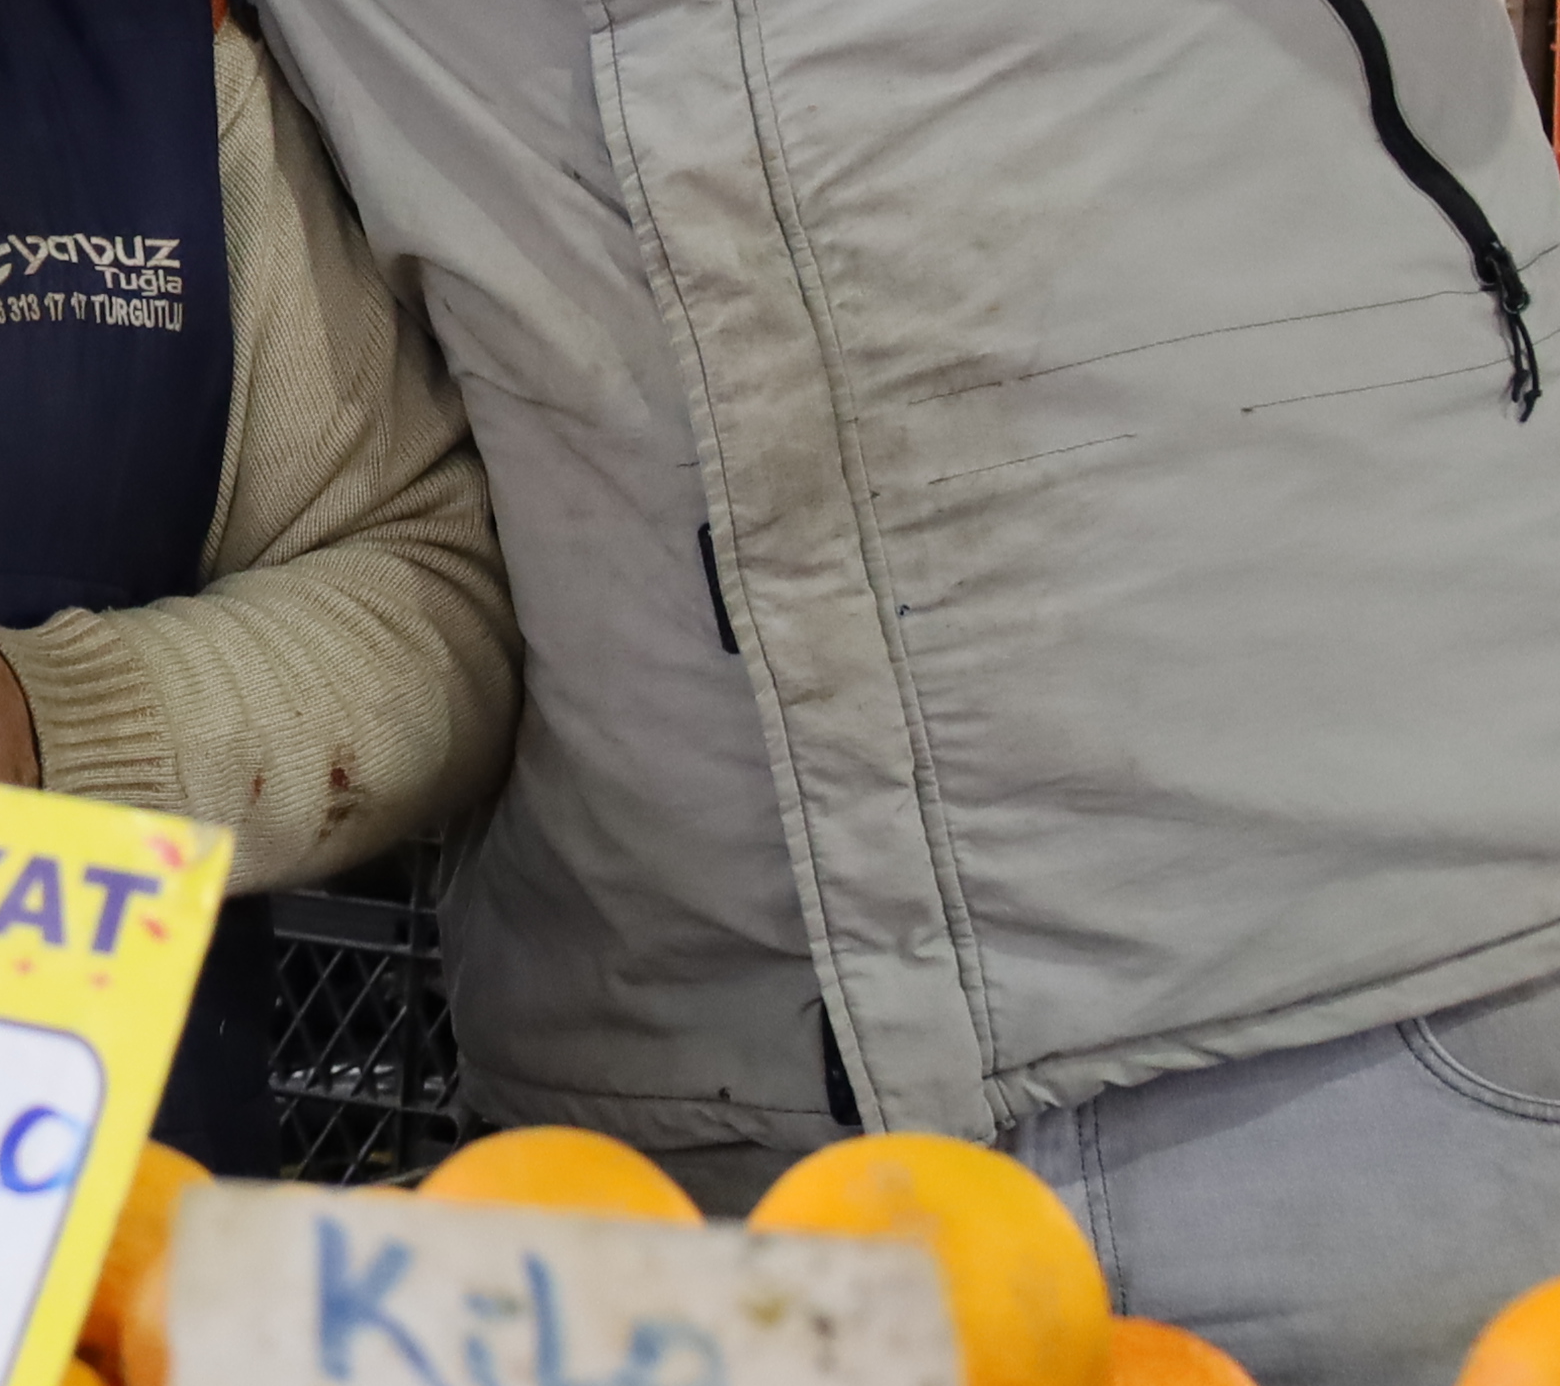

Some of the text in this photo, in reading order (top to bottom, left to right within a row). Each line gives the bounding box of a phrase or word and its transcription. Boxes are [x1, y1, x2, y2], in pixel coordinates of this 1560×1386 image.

[94, 265, 183, 297] Tuğla
[7, 293, 41, 322] 313
[44, 291, 66, 322] 17
